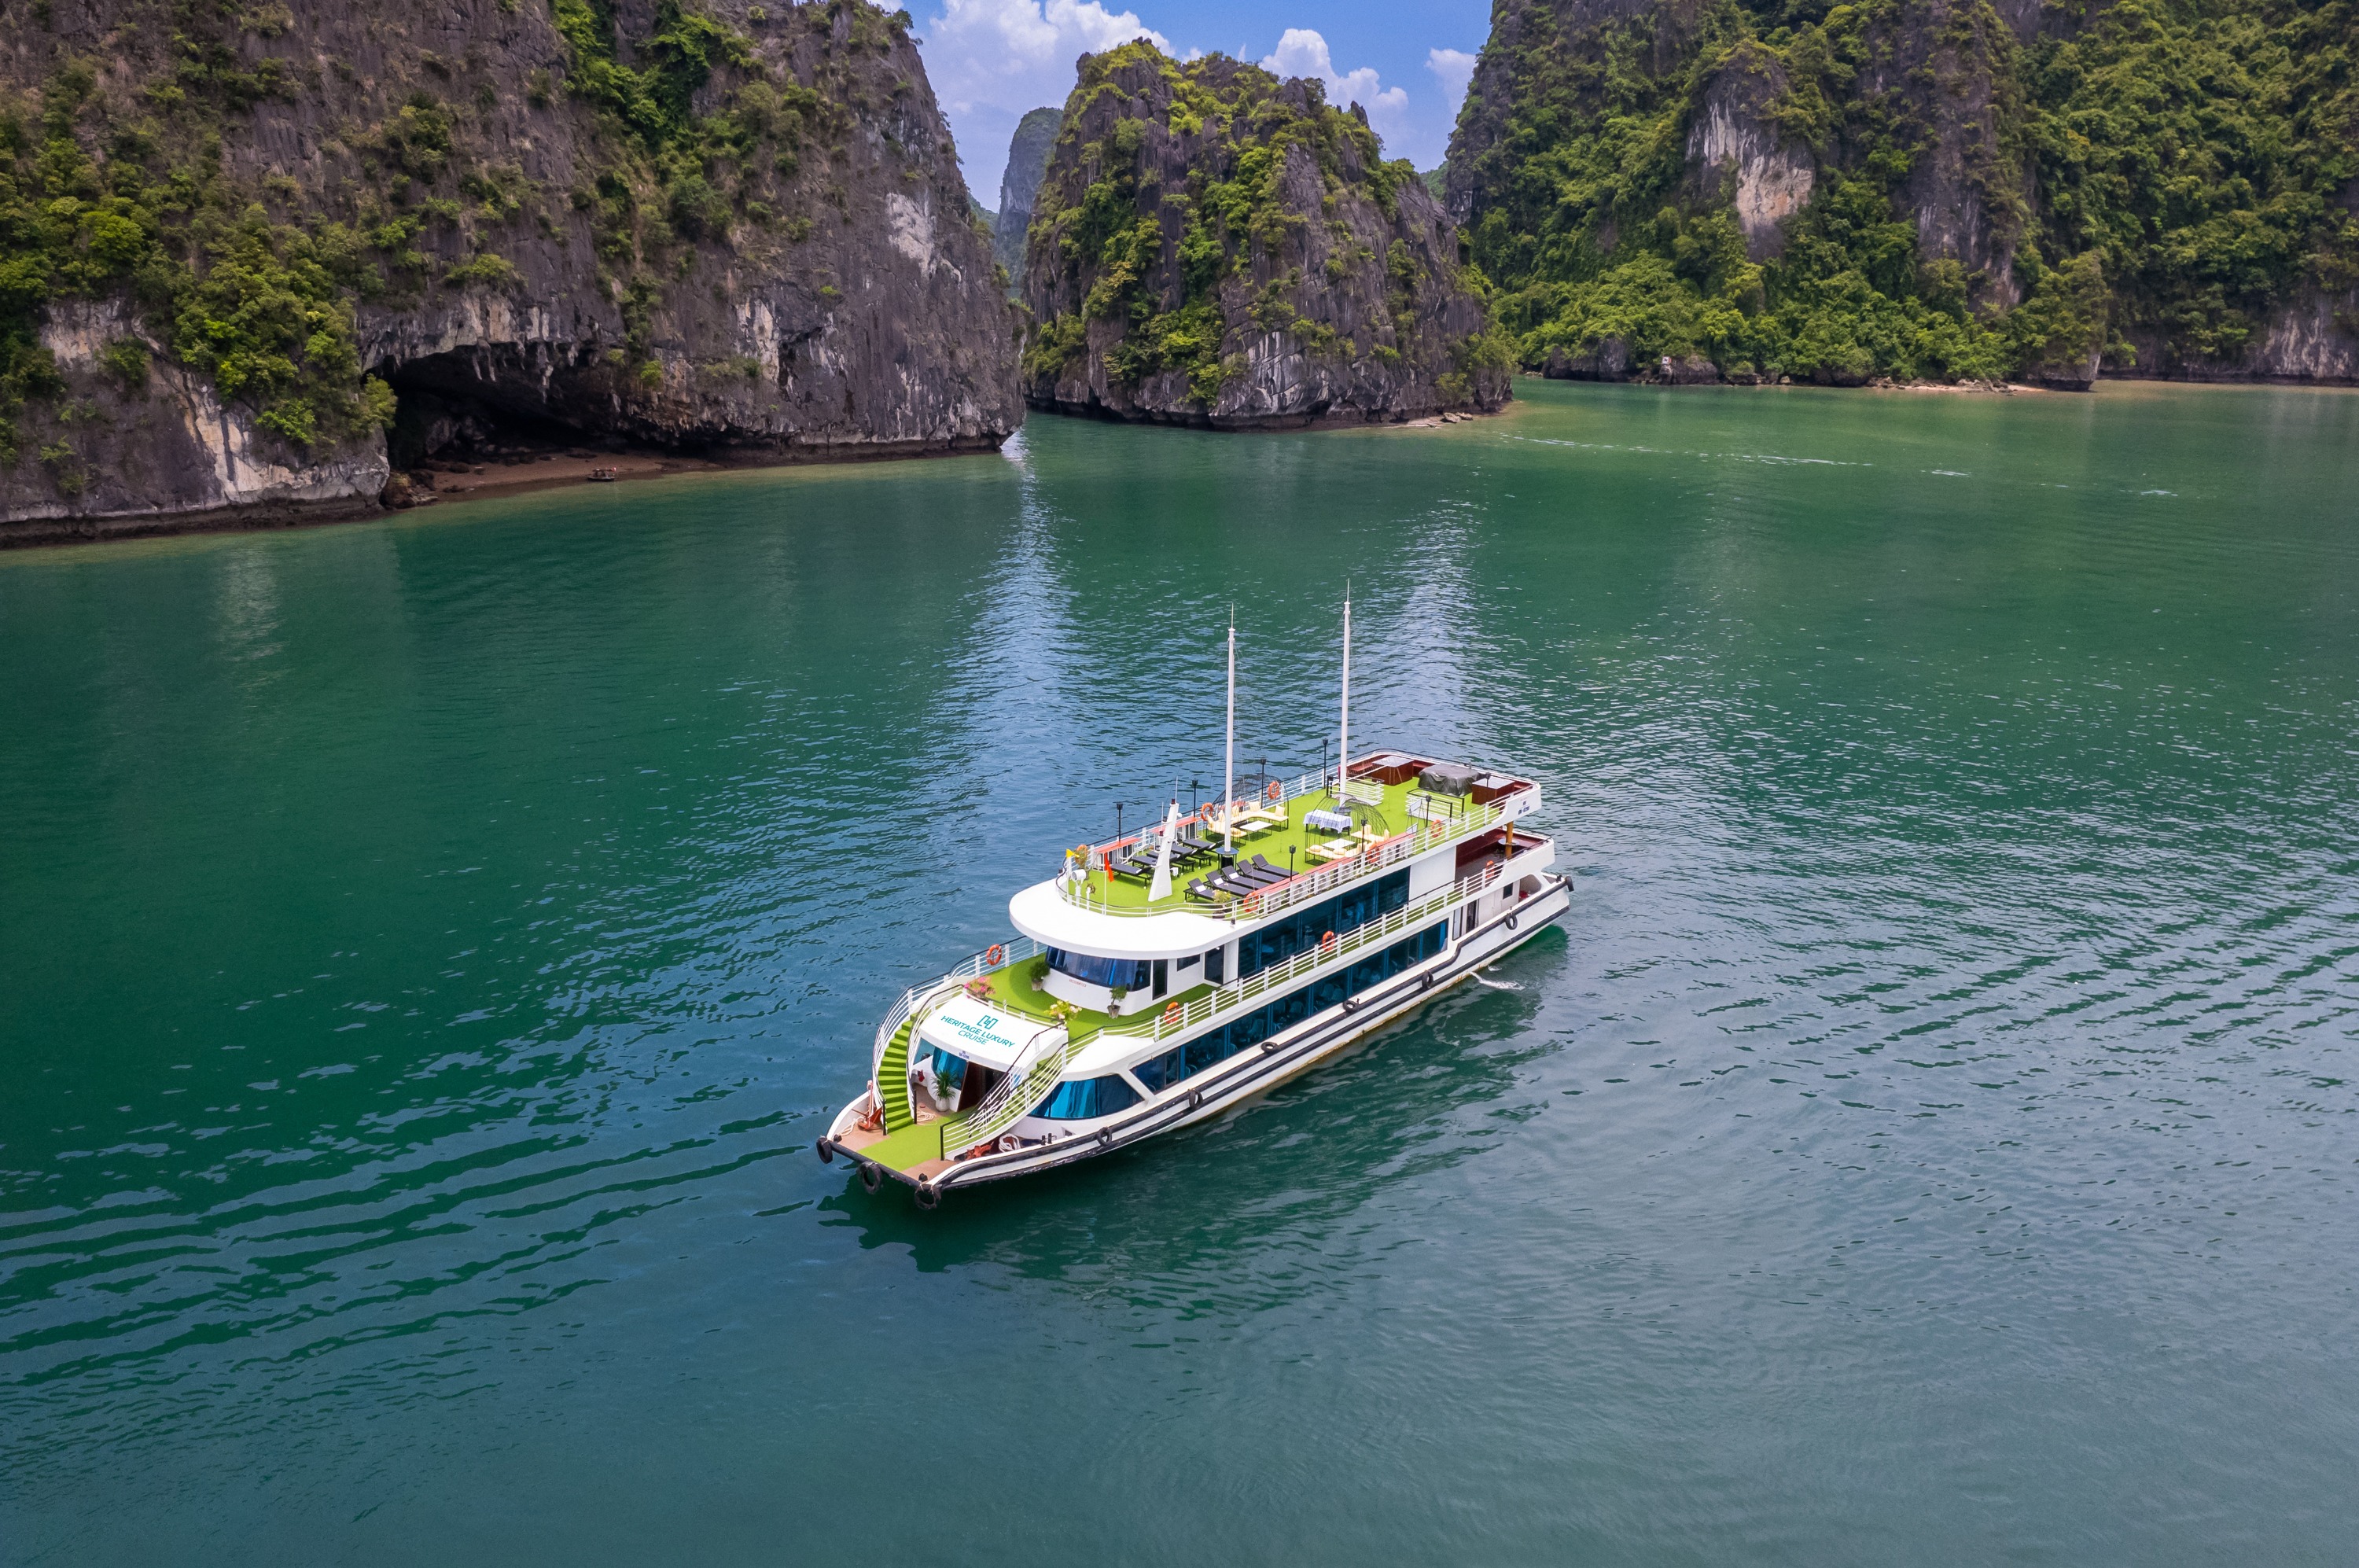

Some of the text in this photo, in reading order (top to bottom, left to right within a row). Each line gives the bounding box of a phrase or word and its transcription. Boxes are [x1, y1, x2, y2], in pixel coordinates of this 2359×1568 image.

[940, 1015, 1016, 1047] HERITAGE LUXURY
[958, 1030, 989, 1045] CRUISE
